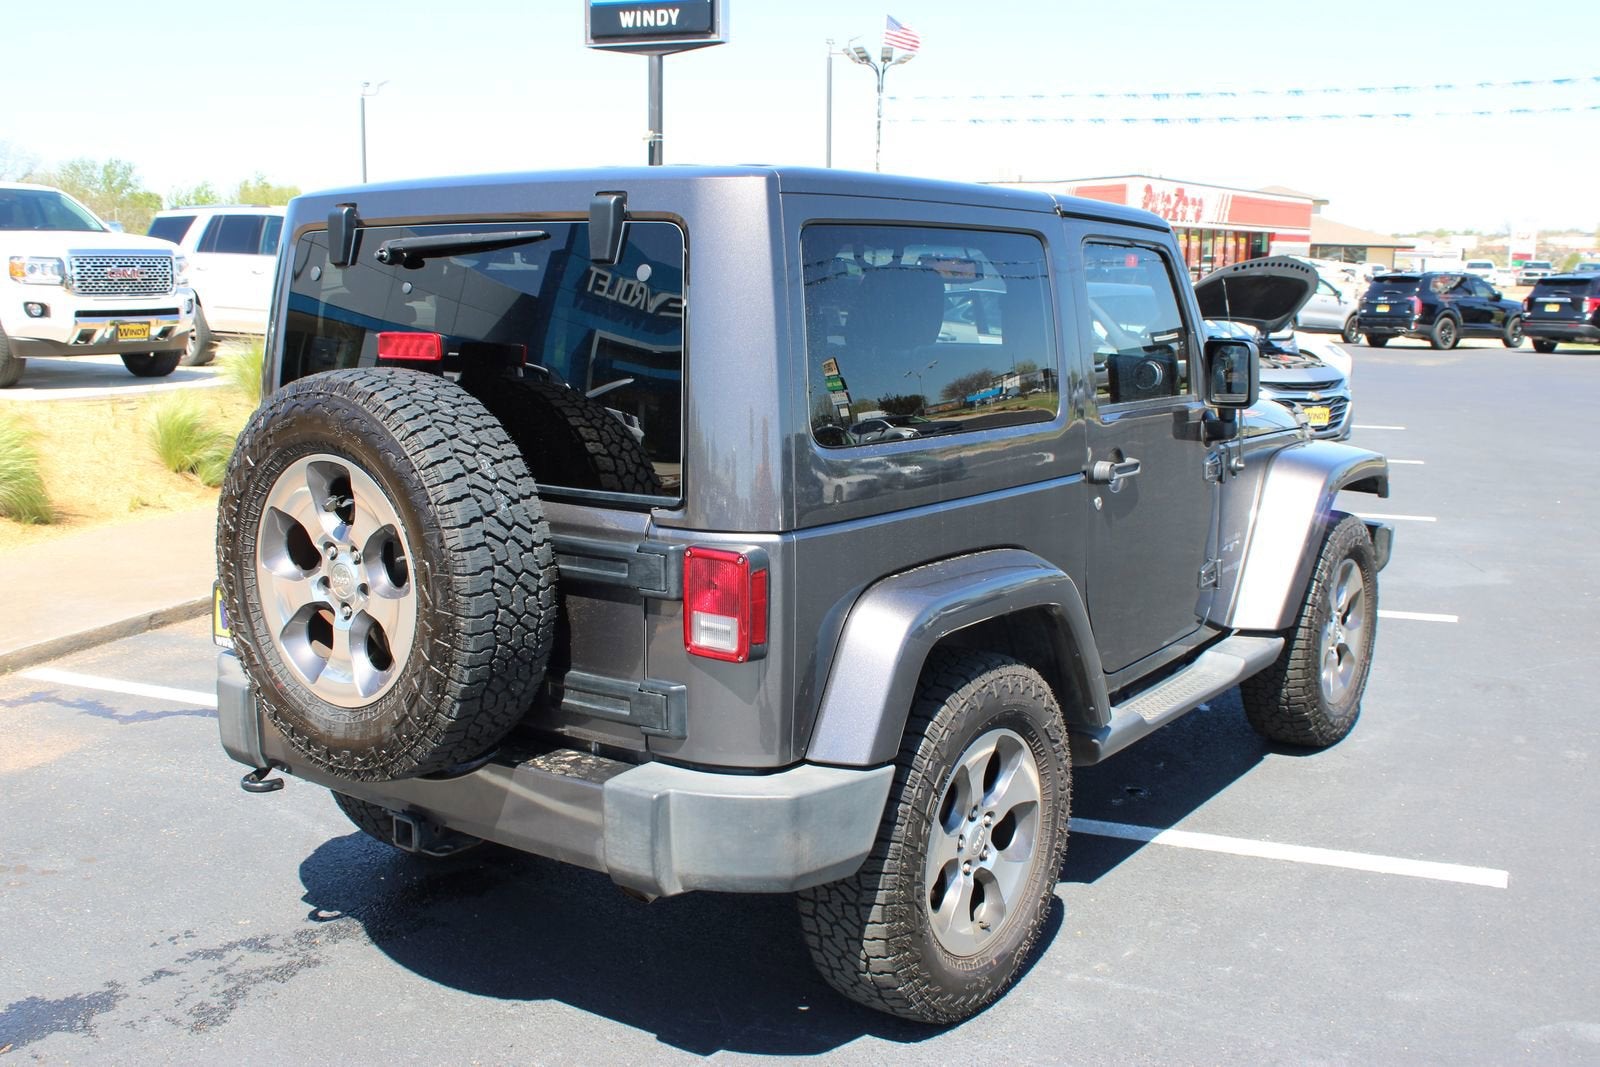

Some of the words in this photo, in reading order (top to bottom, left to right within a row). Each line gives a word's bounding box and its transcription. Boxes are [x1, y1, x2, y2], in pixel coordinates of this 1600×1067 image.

[619, 8, 680, 28] WINDY
[107, 268, 147, 279] GMC
[119, 327, 148, 337] WINDY
